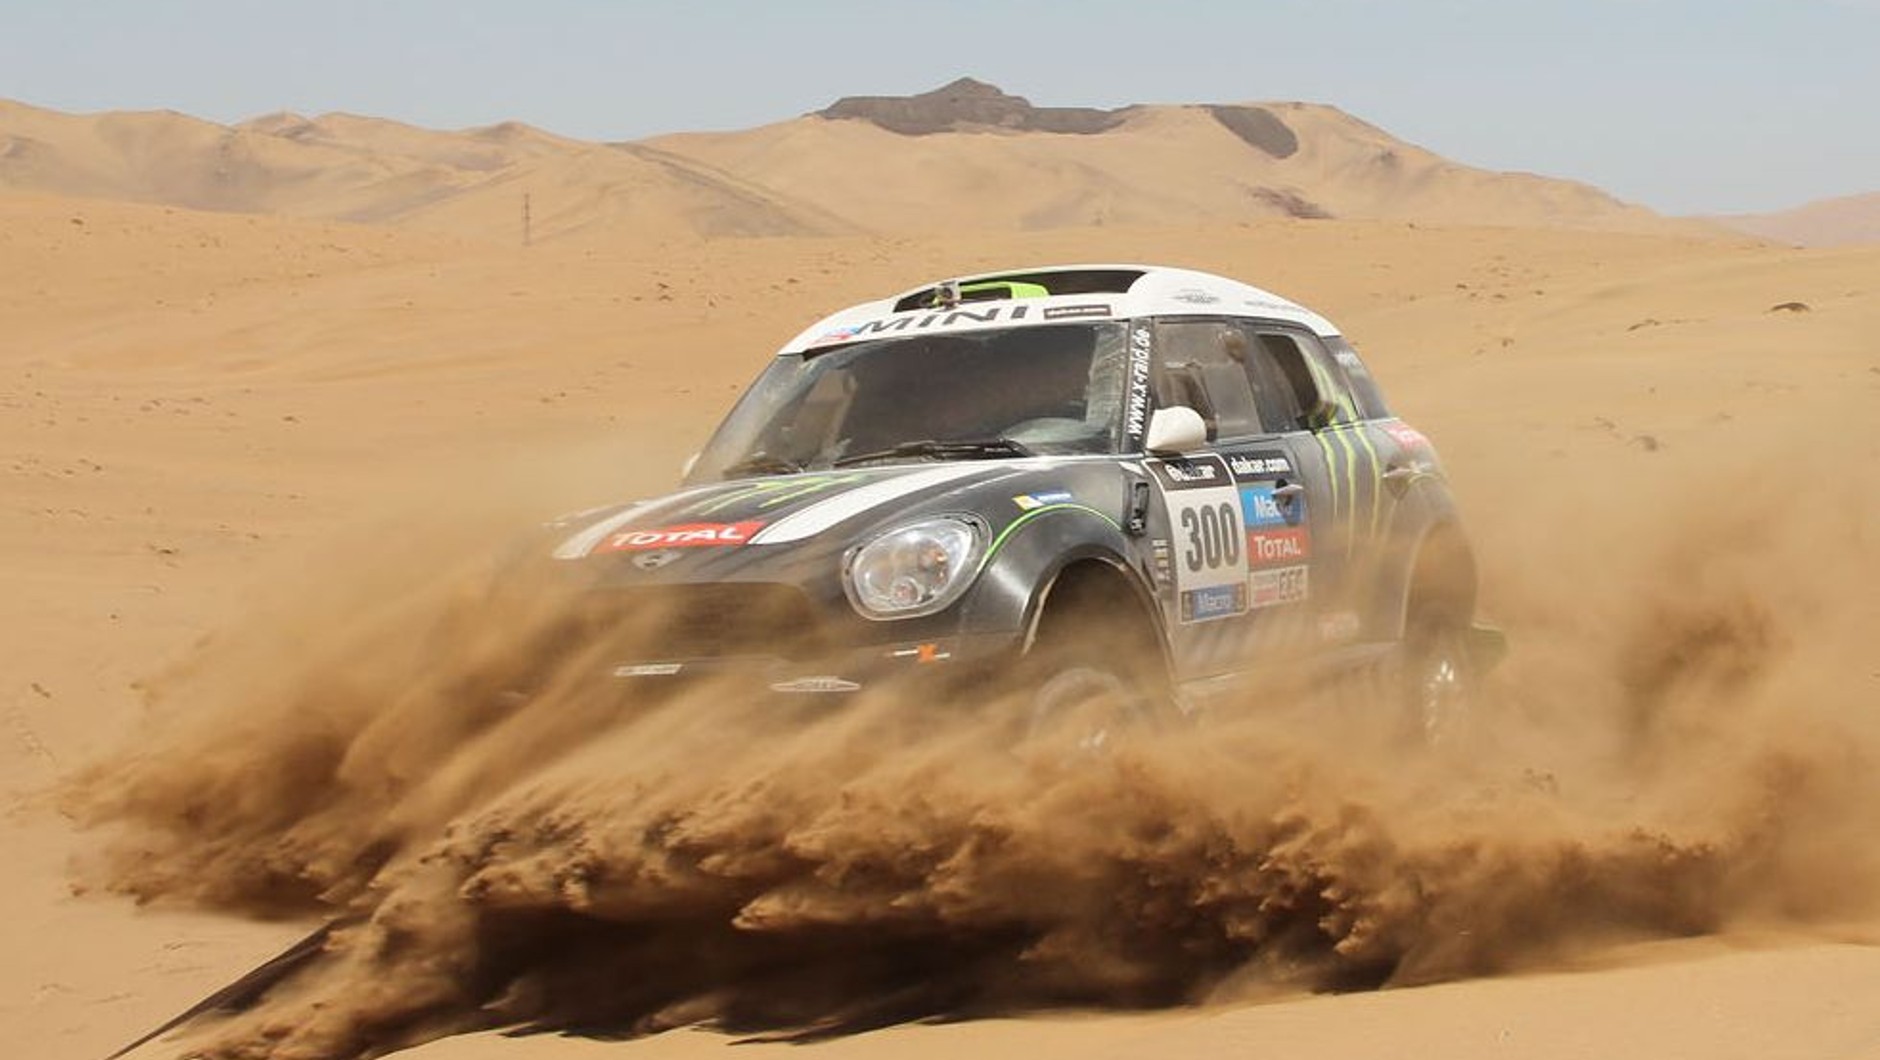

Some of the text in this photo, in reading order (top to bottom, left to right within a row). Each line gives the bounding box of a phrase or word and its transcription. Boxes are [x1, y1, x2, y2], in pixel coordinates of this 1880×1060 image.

[854, 306, 1028, 335] MINI
[613, 527, 745, 547] TOTAL
[1180, 502, 1240, 572] 300
